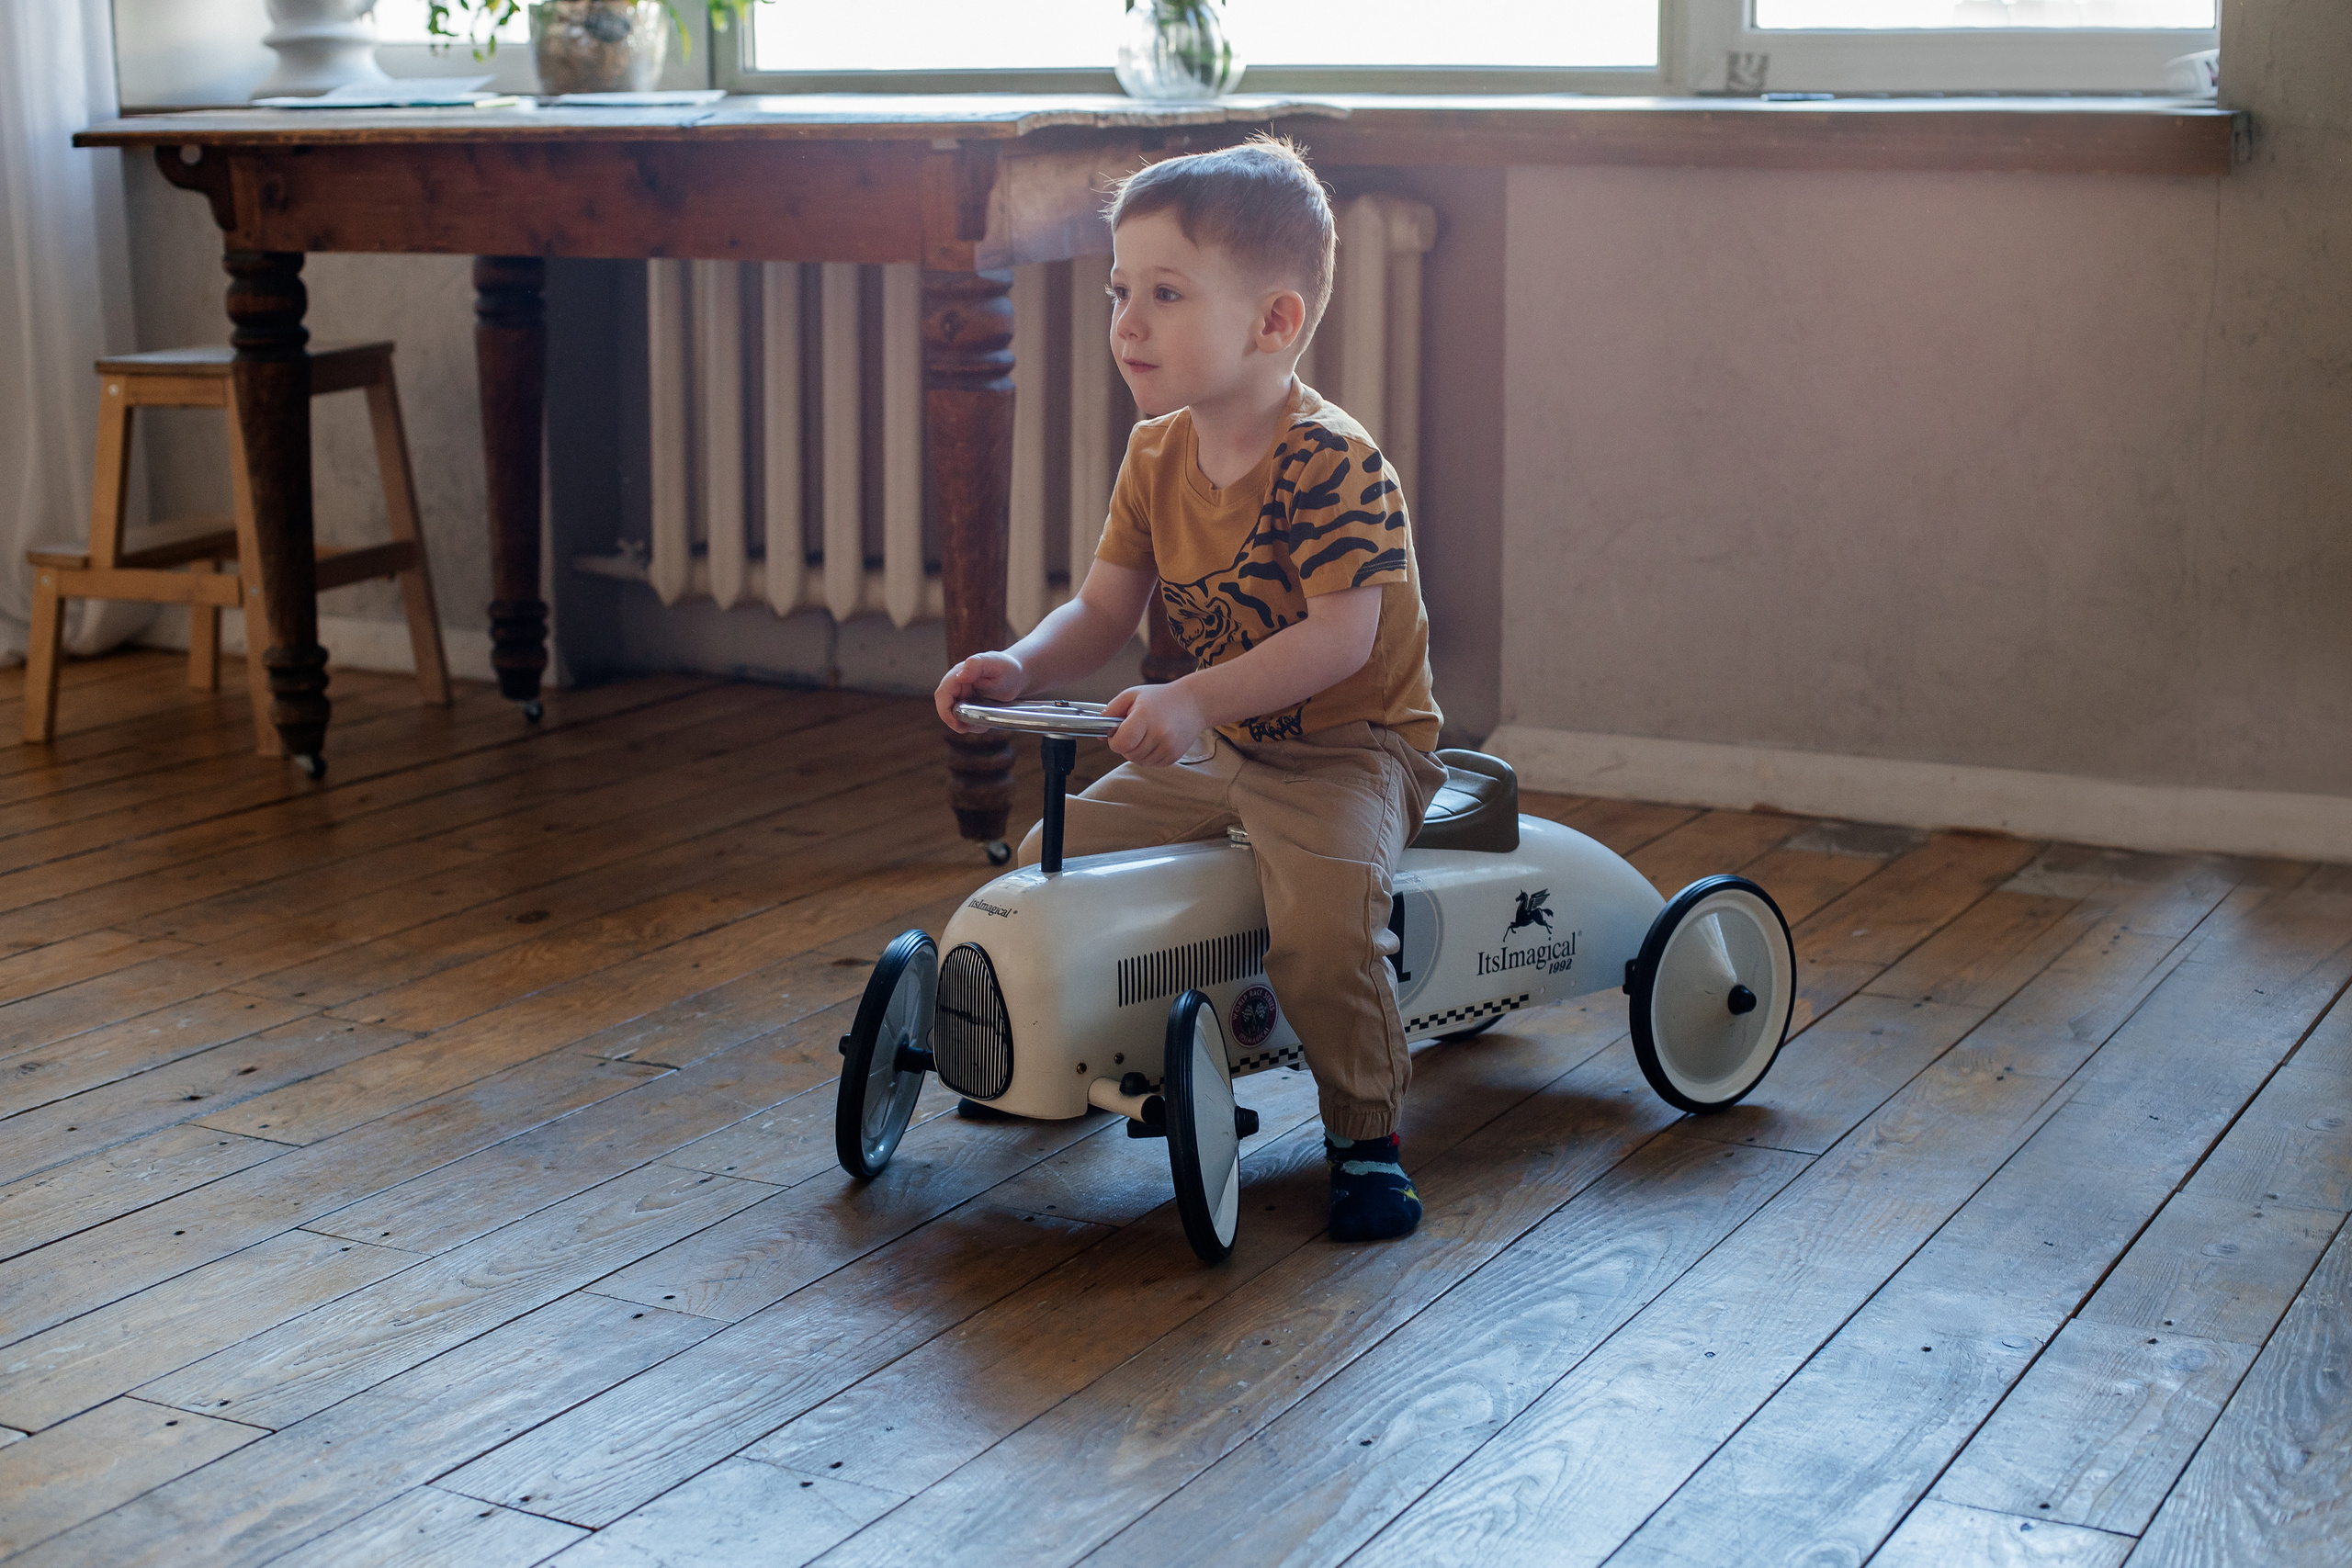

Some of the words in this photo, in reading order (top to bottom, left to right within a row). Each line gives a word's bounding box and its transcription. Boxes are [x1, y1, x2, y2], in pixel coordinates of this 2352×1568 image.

[967, 897, 1012, 919] ItsImagical
[1476, 931, 1577, 976] ItsImagical
[1548, 957, 1574, 976] 1992
[1233, 995, 1248, 1021] WORLD
[1250, 989, 1263, 998] RACE
[1263, 992, 1275, 1011] SERIES
